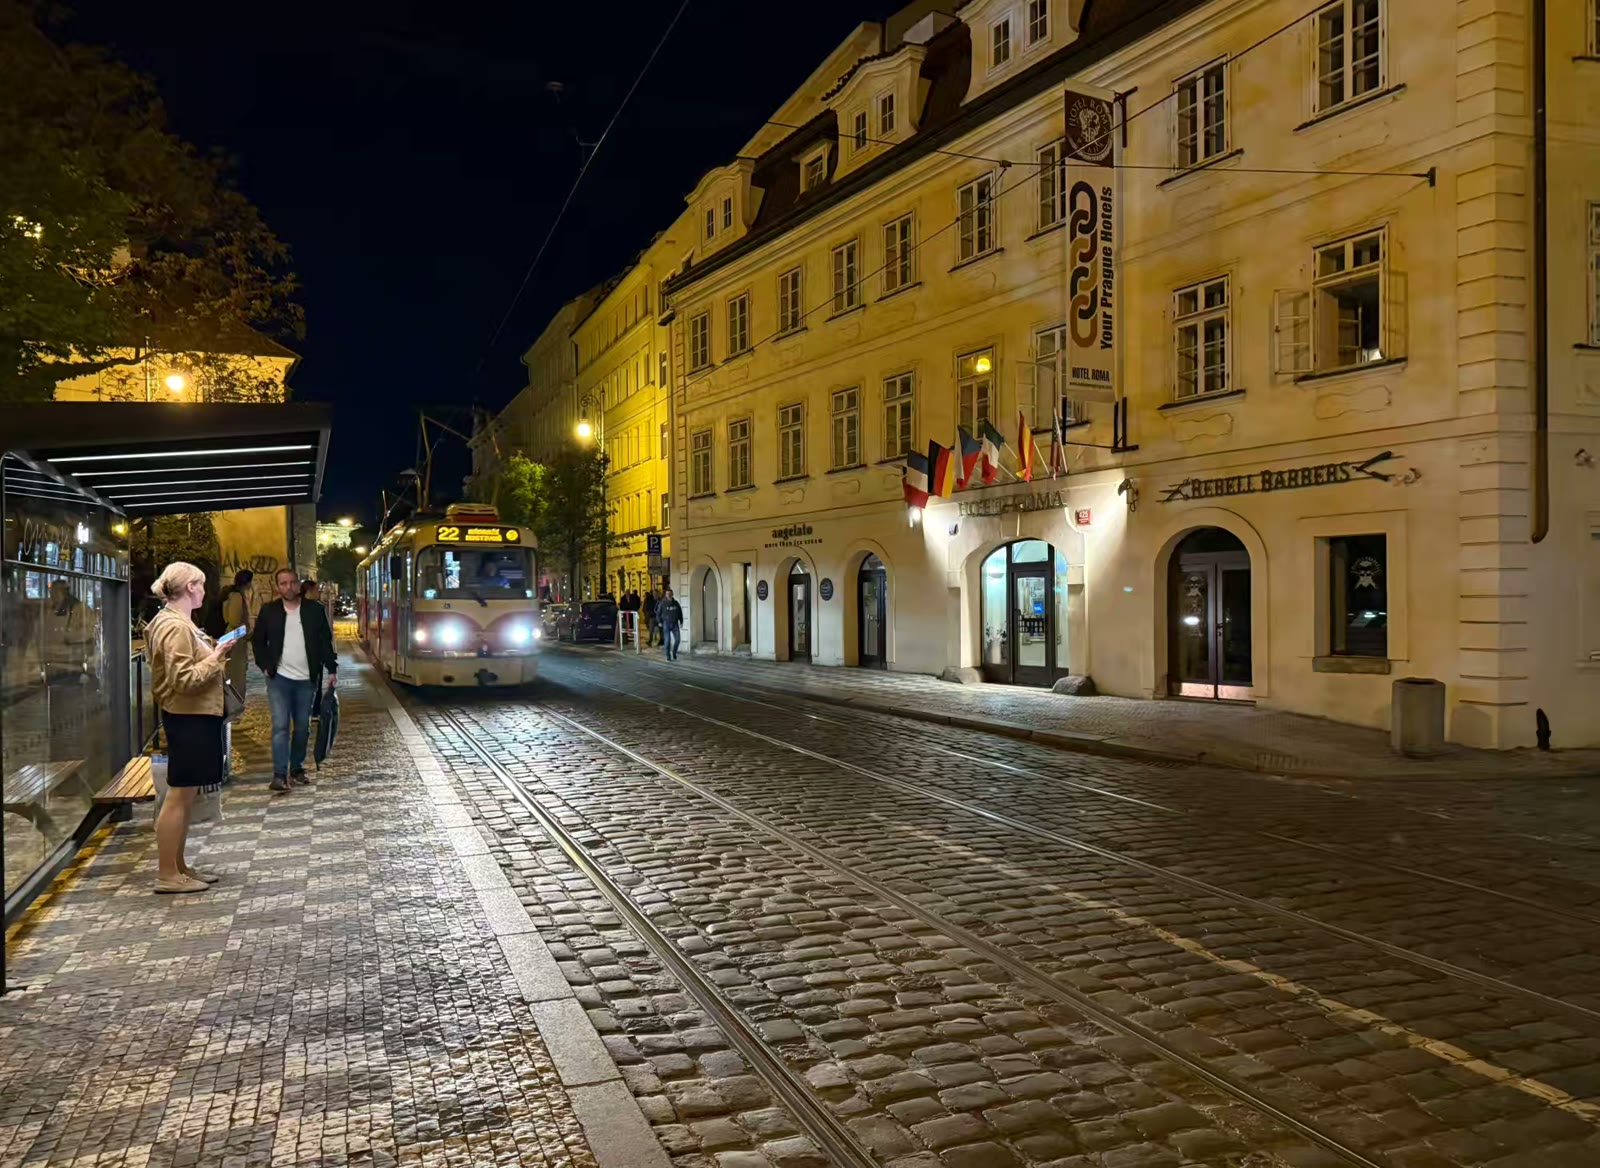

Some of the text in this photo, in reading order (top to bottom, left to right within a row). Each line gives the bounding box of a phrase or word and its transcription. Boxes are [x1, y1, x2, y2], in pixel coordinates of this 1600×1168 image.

[1068, 98, 1087, 127] HOTEL
[1100, 185, 1114, 351] Your Prague Hotels
[1072, 366, 1110, 382] HOTEL ROMA
[1191, 462, 1350, 498] REBELL BARBERS
[438, 526, 460, 541] 22
[771, 524, 813, 540] angelato
[650, 536, 659, 549] P
